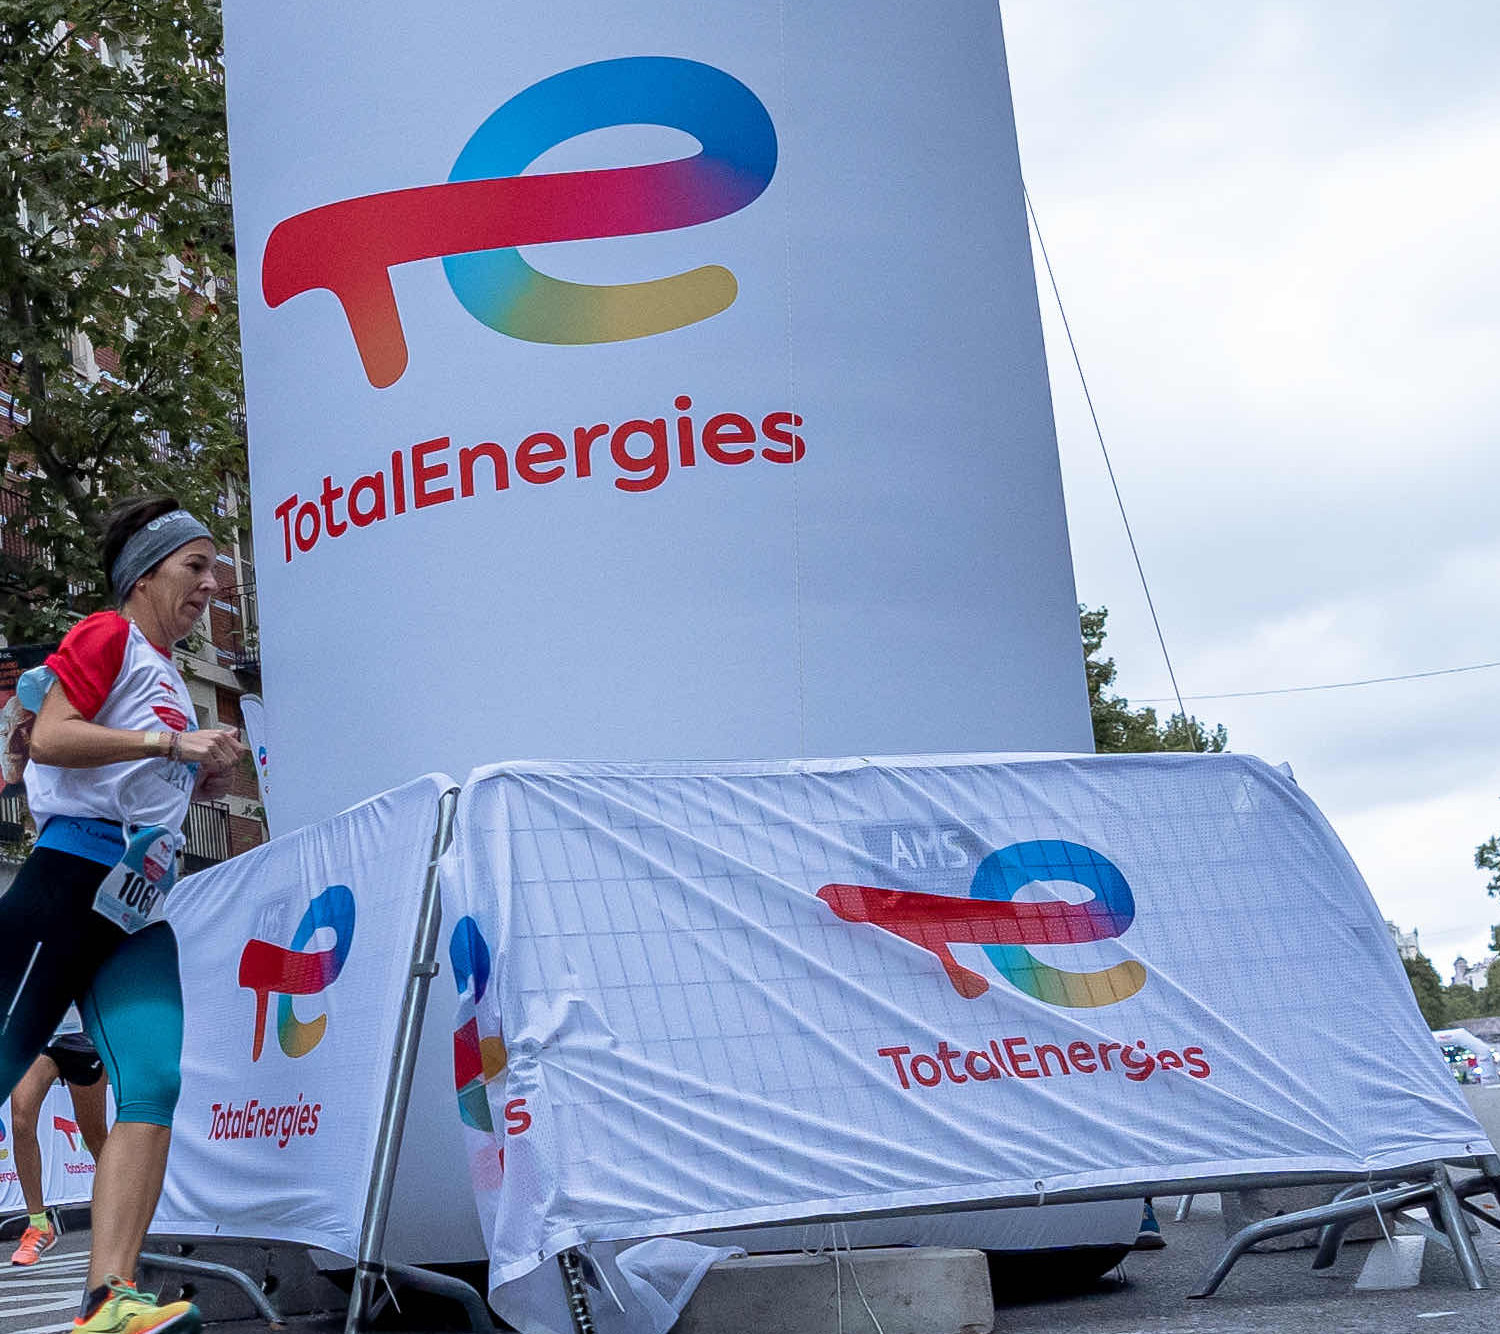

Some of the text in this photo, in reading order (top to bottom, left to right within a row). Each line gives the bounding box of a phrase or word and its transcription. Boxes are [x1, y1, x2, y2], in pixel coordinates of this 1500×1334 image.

[274, 395, 806, 563] TotalEnergies
[892, 830, 968, 869] AMS
[208, 1093, 321, 1148] TotalEnergies
